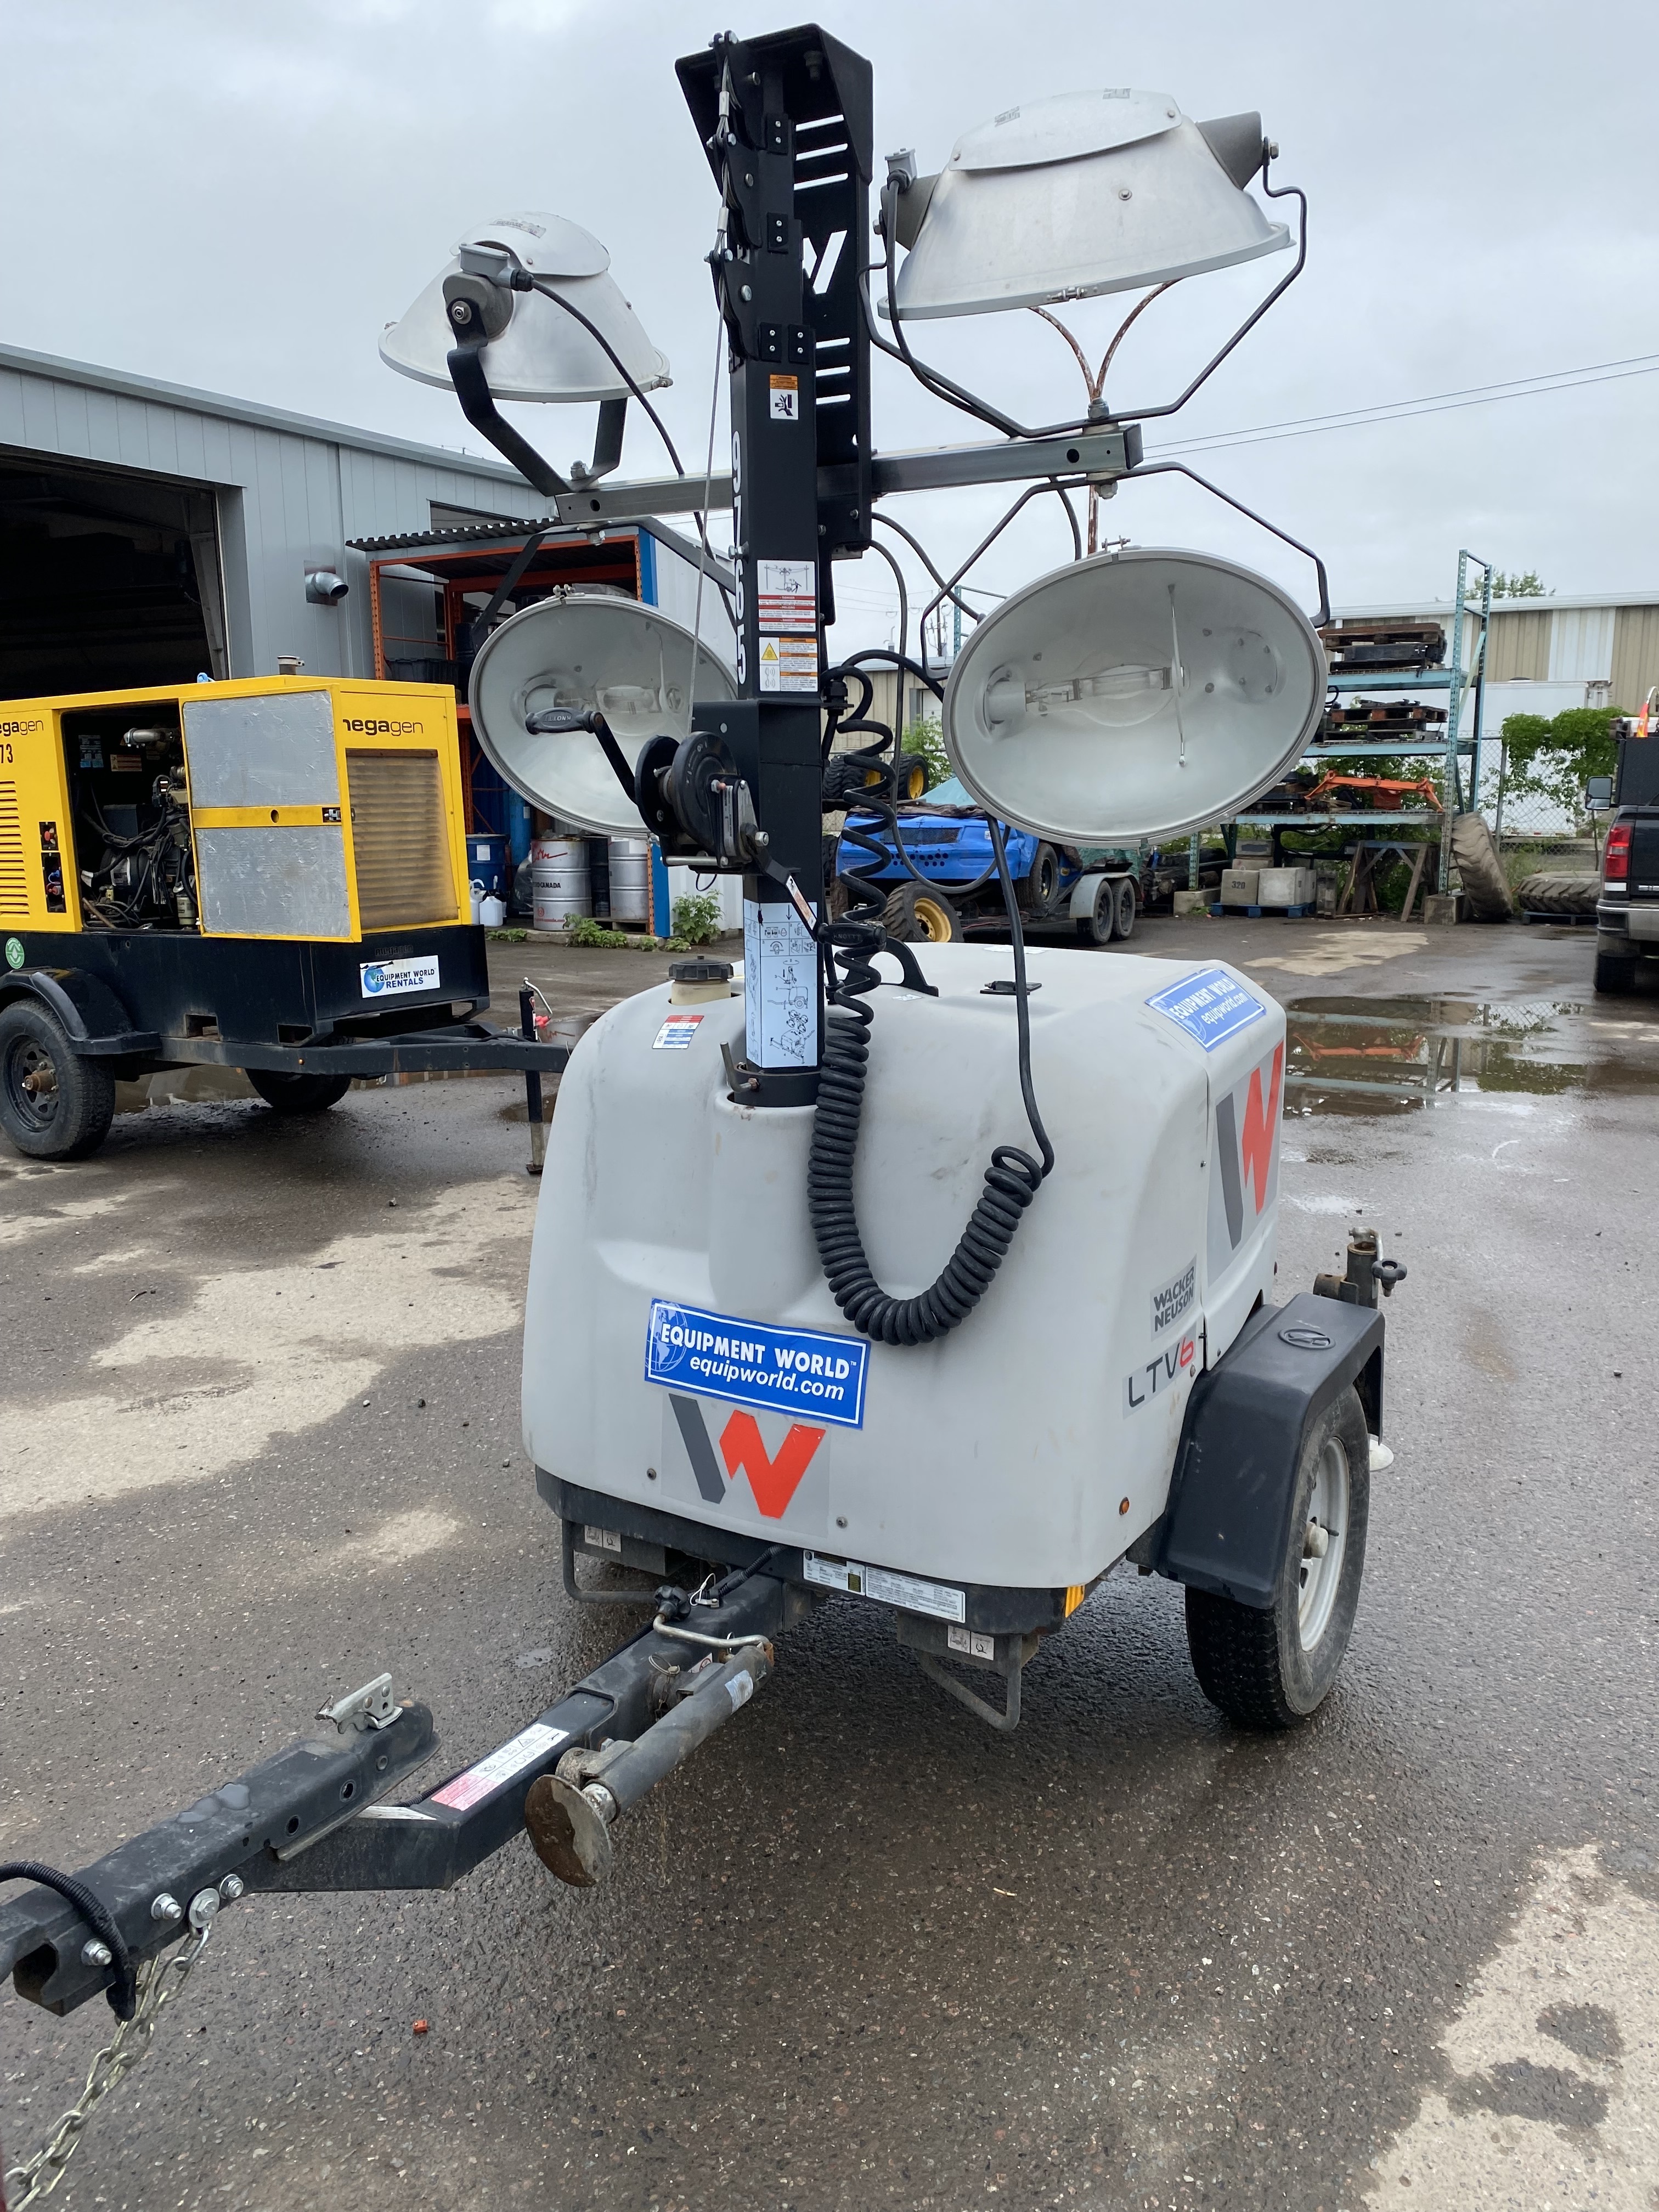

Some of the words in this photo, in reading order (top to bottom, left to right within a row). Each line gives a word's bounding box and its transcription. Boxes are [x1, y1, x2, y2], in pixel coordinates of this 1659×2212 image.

[376, 972, 410, 982] EQUIPMENT
[386, 977, 424, 989] RENTALS
[1169, 988, 1216, 1020] EQUIPMENT
[1207, 978, 1236, 996] WORLD
[1201, 992, 1249, 1025] equipworld.com
[1154, 1266, 1194, 1312] WACKER
[1154, 1282, 1194, 1332] NEUSON
[661, 1323, 766, 1364] EQUIPMENT
[690, 1357, 844, 1401] equipworld.com
